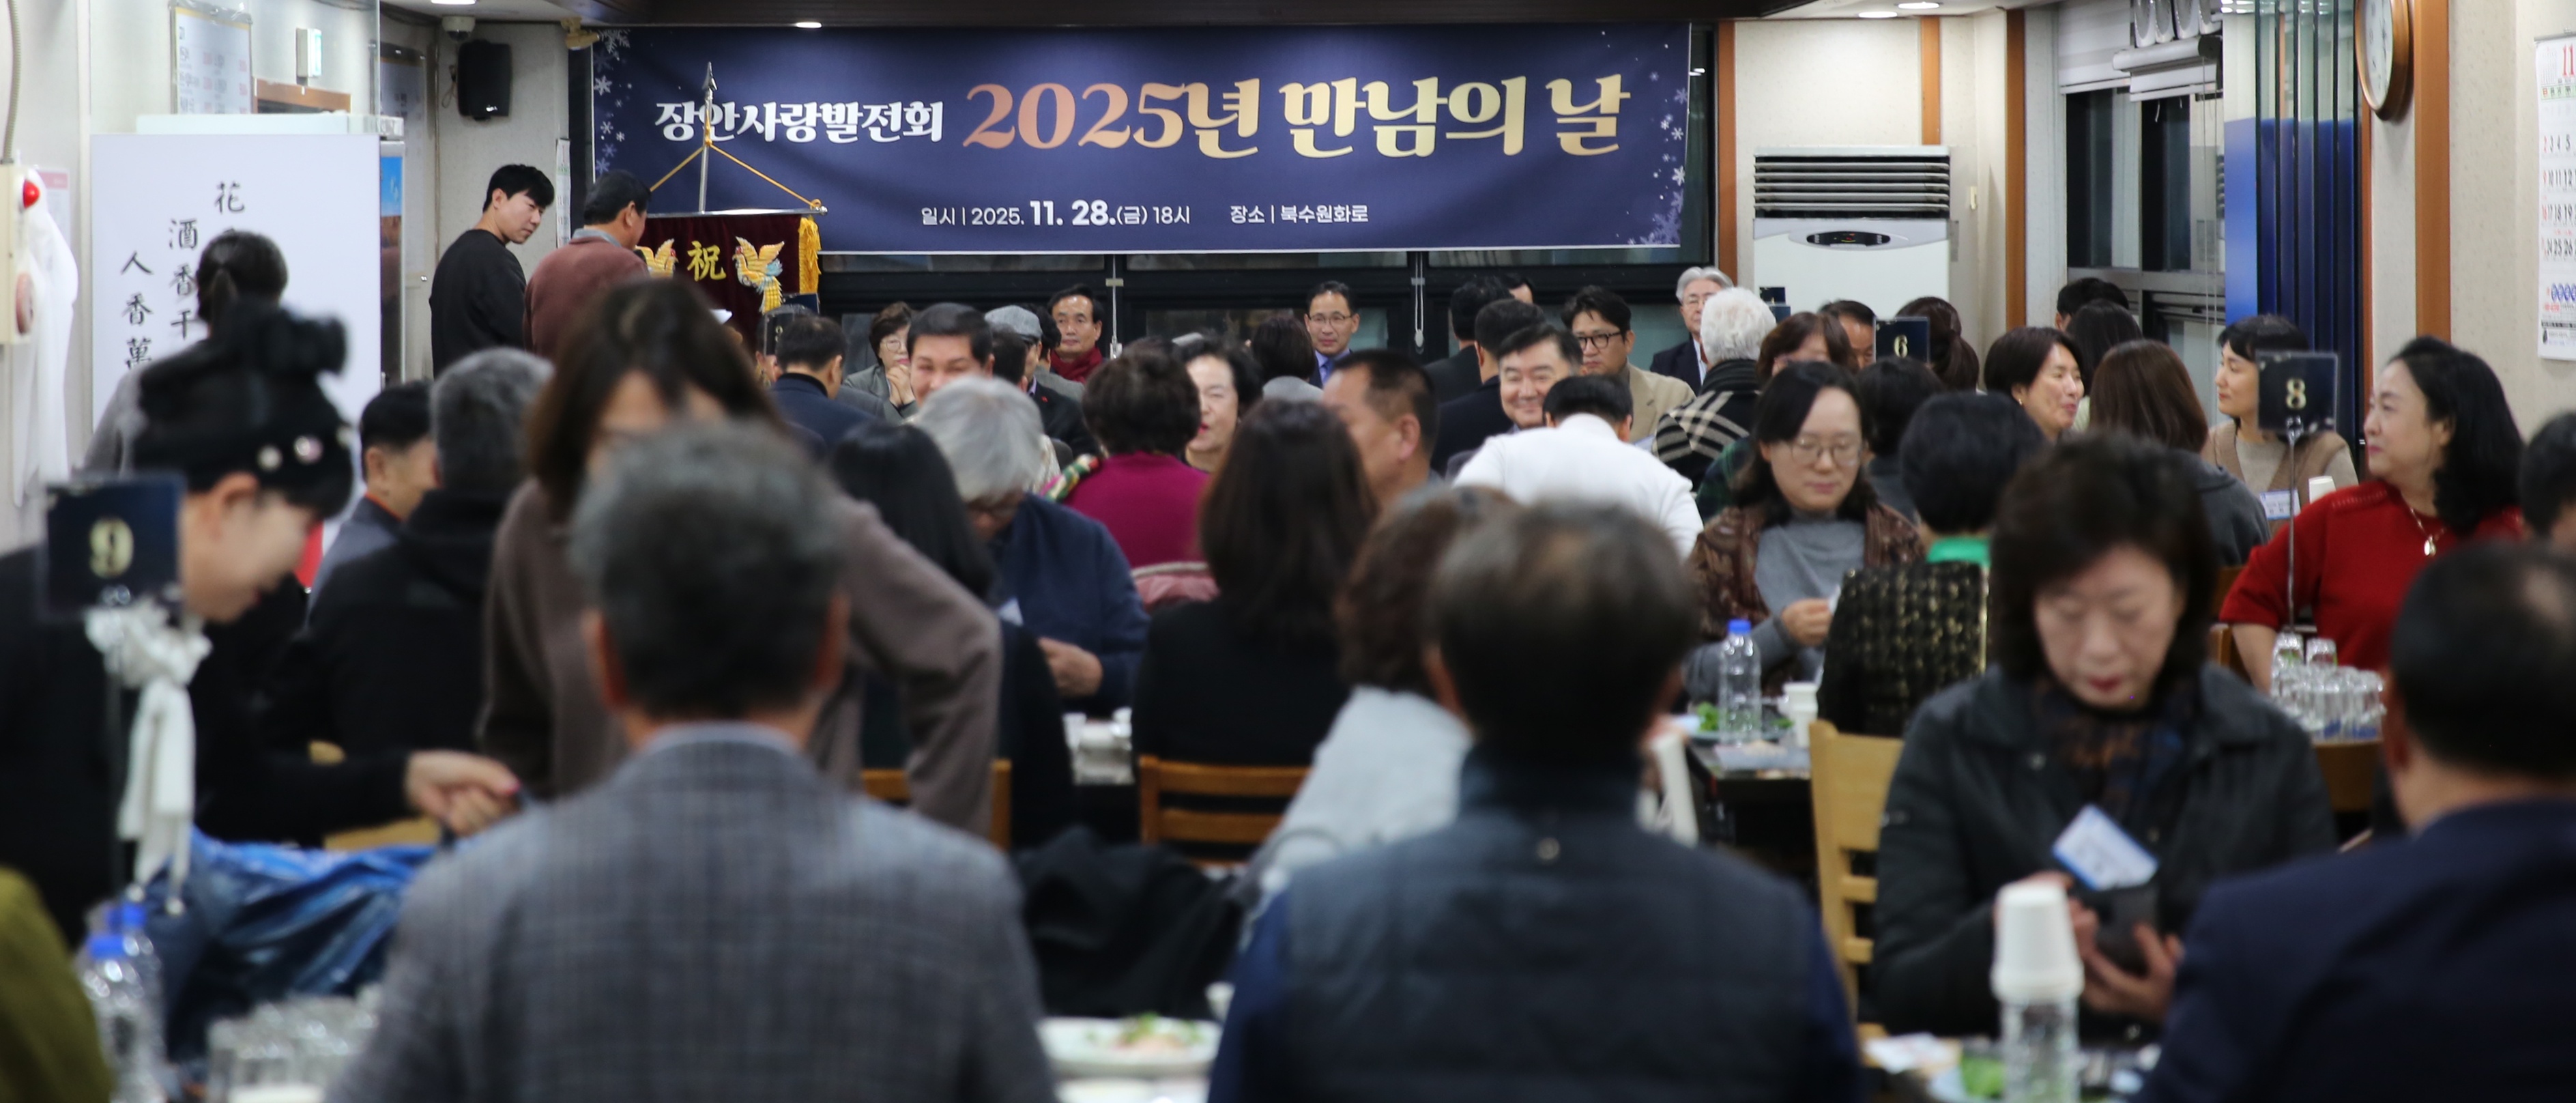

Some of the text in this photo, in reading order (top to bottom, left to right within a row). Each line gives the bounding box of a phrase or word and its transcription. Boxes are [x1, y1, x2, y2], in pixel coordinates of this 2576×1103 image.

[2562, 43, 2575, 76] 11
[654, 74, 1632, 158] 장안사랑발전회 2025년 만남의 날
[921, 207, 955, 225] 일시
[971, 207, 1024, 225] 2025.
[1030, 200, 1063, 226] 11.
[1153, 205, 1190, 225] 18시
[1230, 205, 1265, 224] 장소
[1280, 204, 1369, 223] 북수원화로
[686, 240, 727, 282] 祝
[1894, 334, 1909, 358] 6
[2286, 377, 2306, 410] 8
[89, 517, 135, 578] 9
